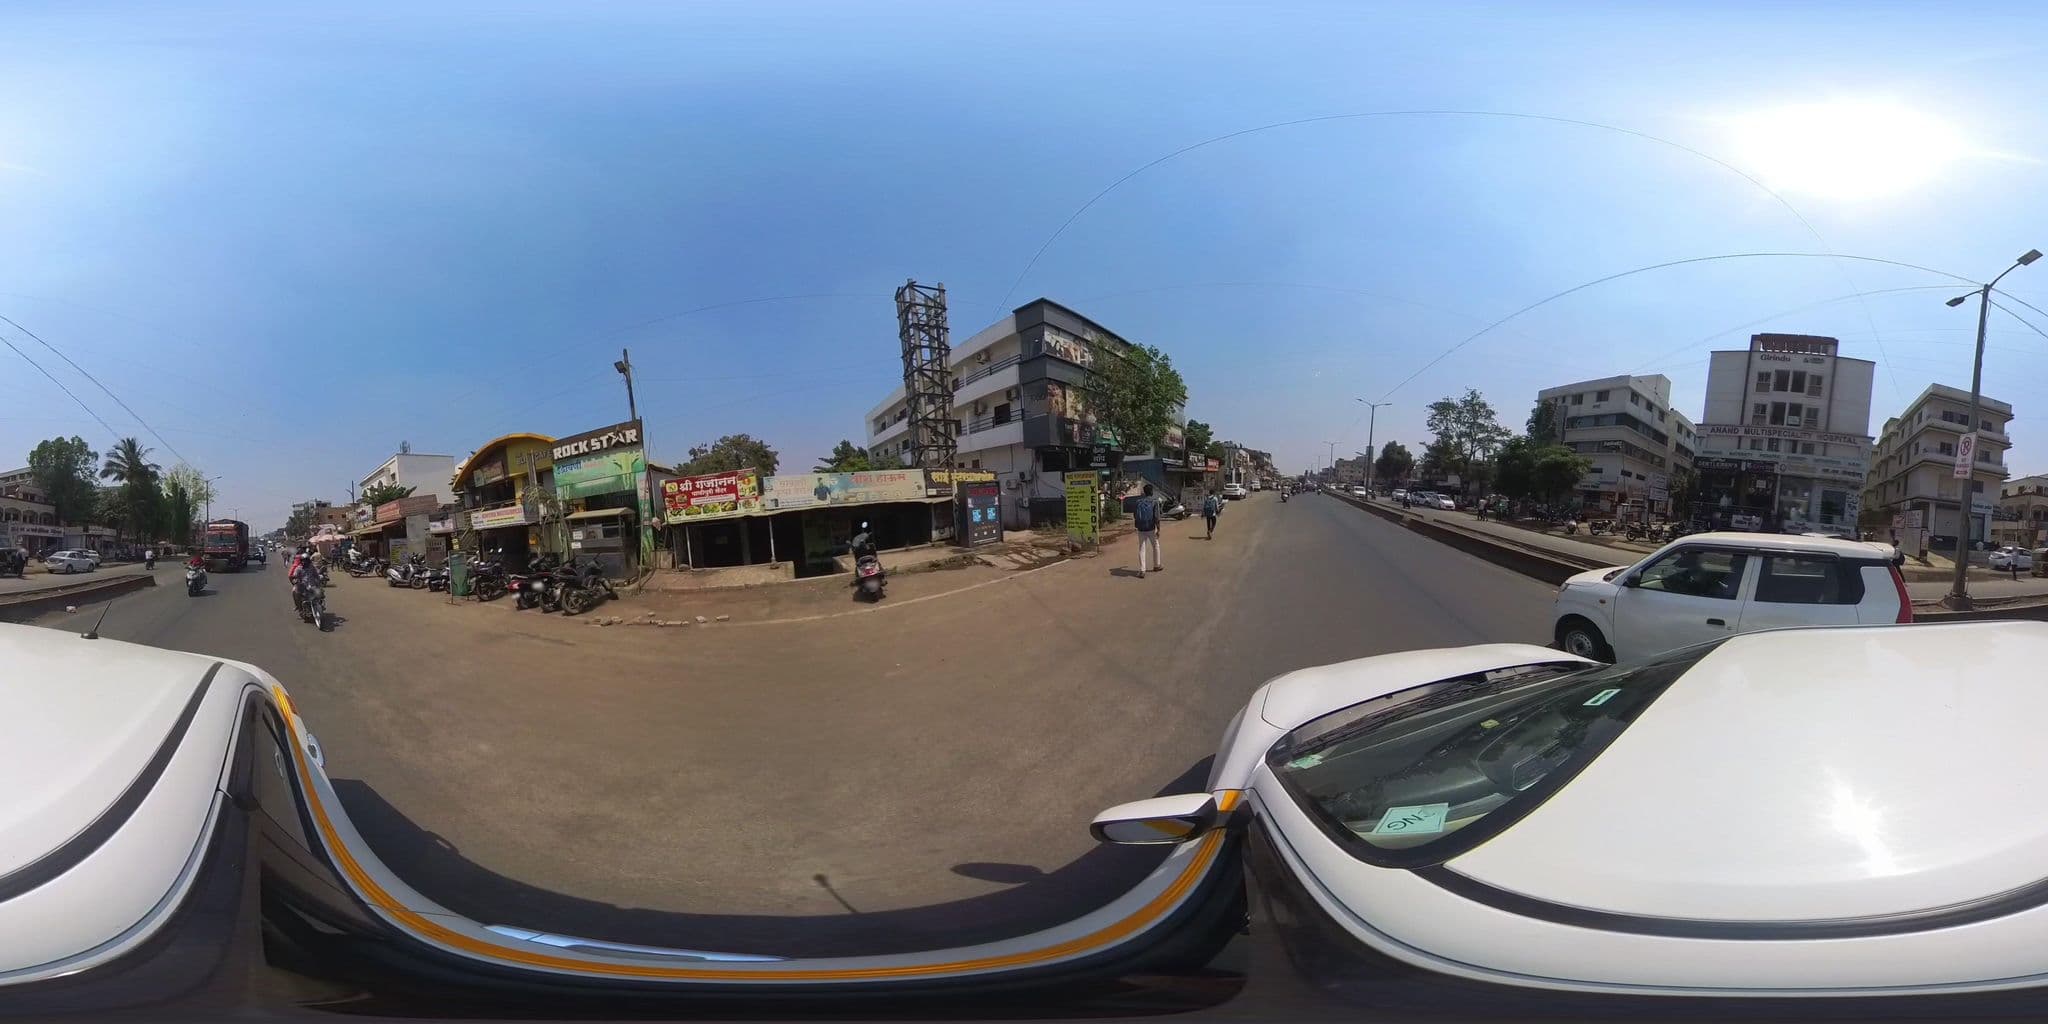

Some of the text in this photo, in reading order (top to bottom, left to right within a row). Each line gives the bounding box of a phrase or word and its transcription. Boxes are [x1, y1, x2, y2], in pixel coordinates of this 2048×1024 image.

[1710, 426, 1739, 434] ANAND
[1744, 428, 1812, 440] MULTISPECIALITY
[553, 440, 589, 460] ROCK
[591, 428, 638, 450] STAR
[679, 476, 736, 492] श्री गजानन
